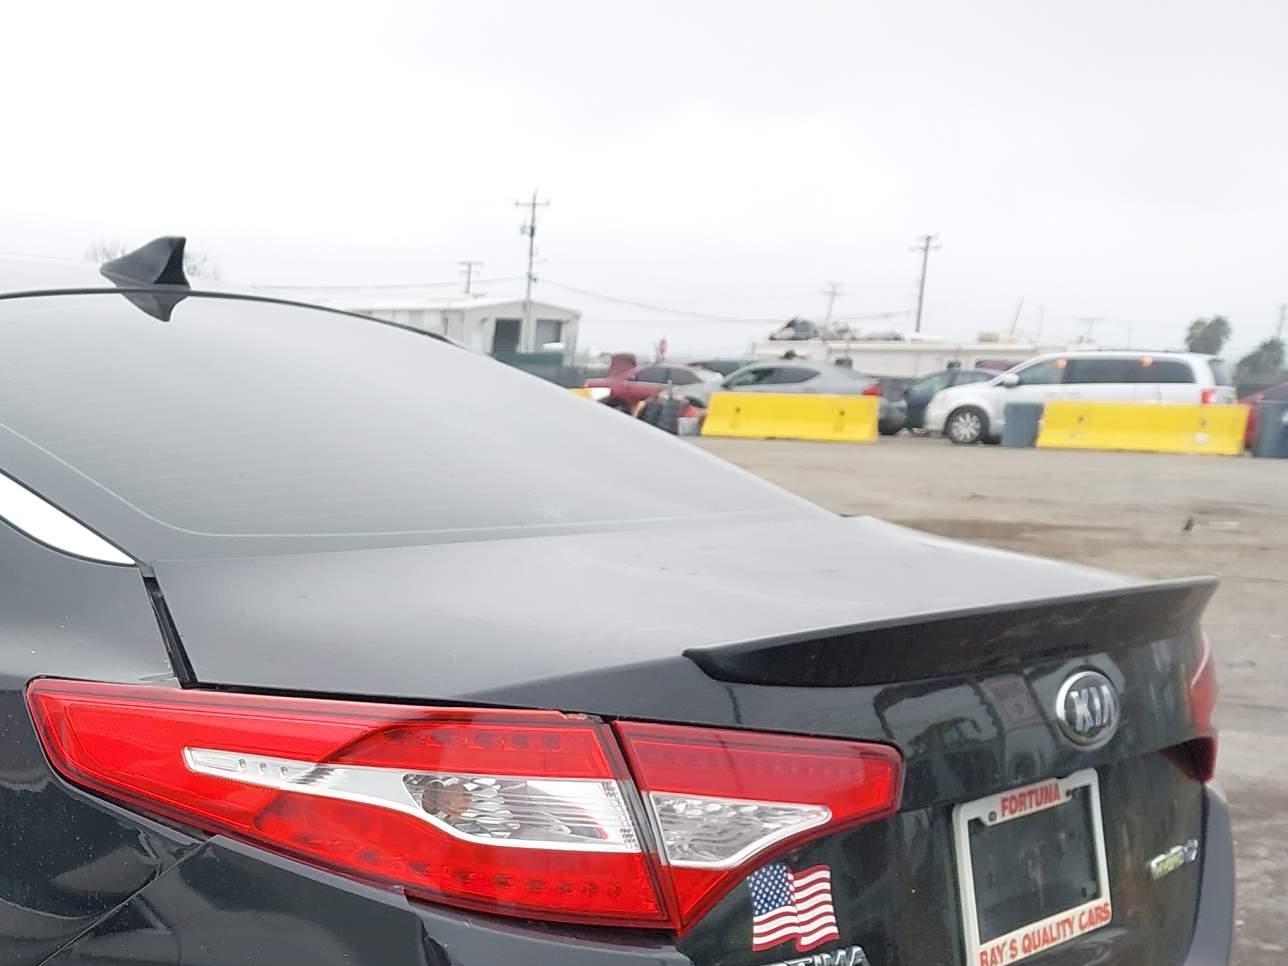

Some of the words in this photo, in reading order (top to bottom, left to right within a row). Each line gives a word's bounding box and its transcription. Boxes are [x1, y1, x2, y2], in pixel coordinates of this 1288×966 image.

[1069, 684, 1113, 732] KIA
[1000, 782, 1061, 818] FORTUNA
[1022, 915, 1075, 953] QUALITY
[1078, 902, 1111, 931] CARS
